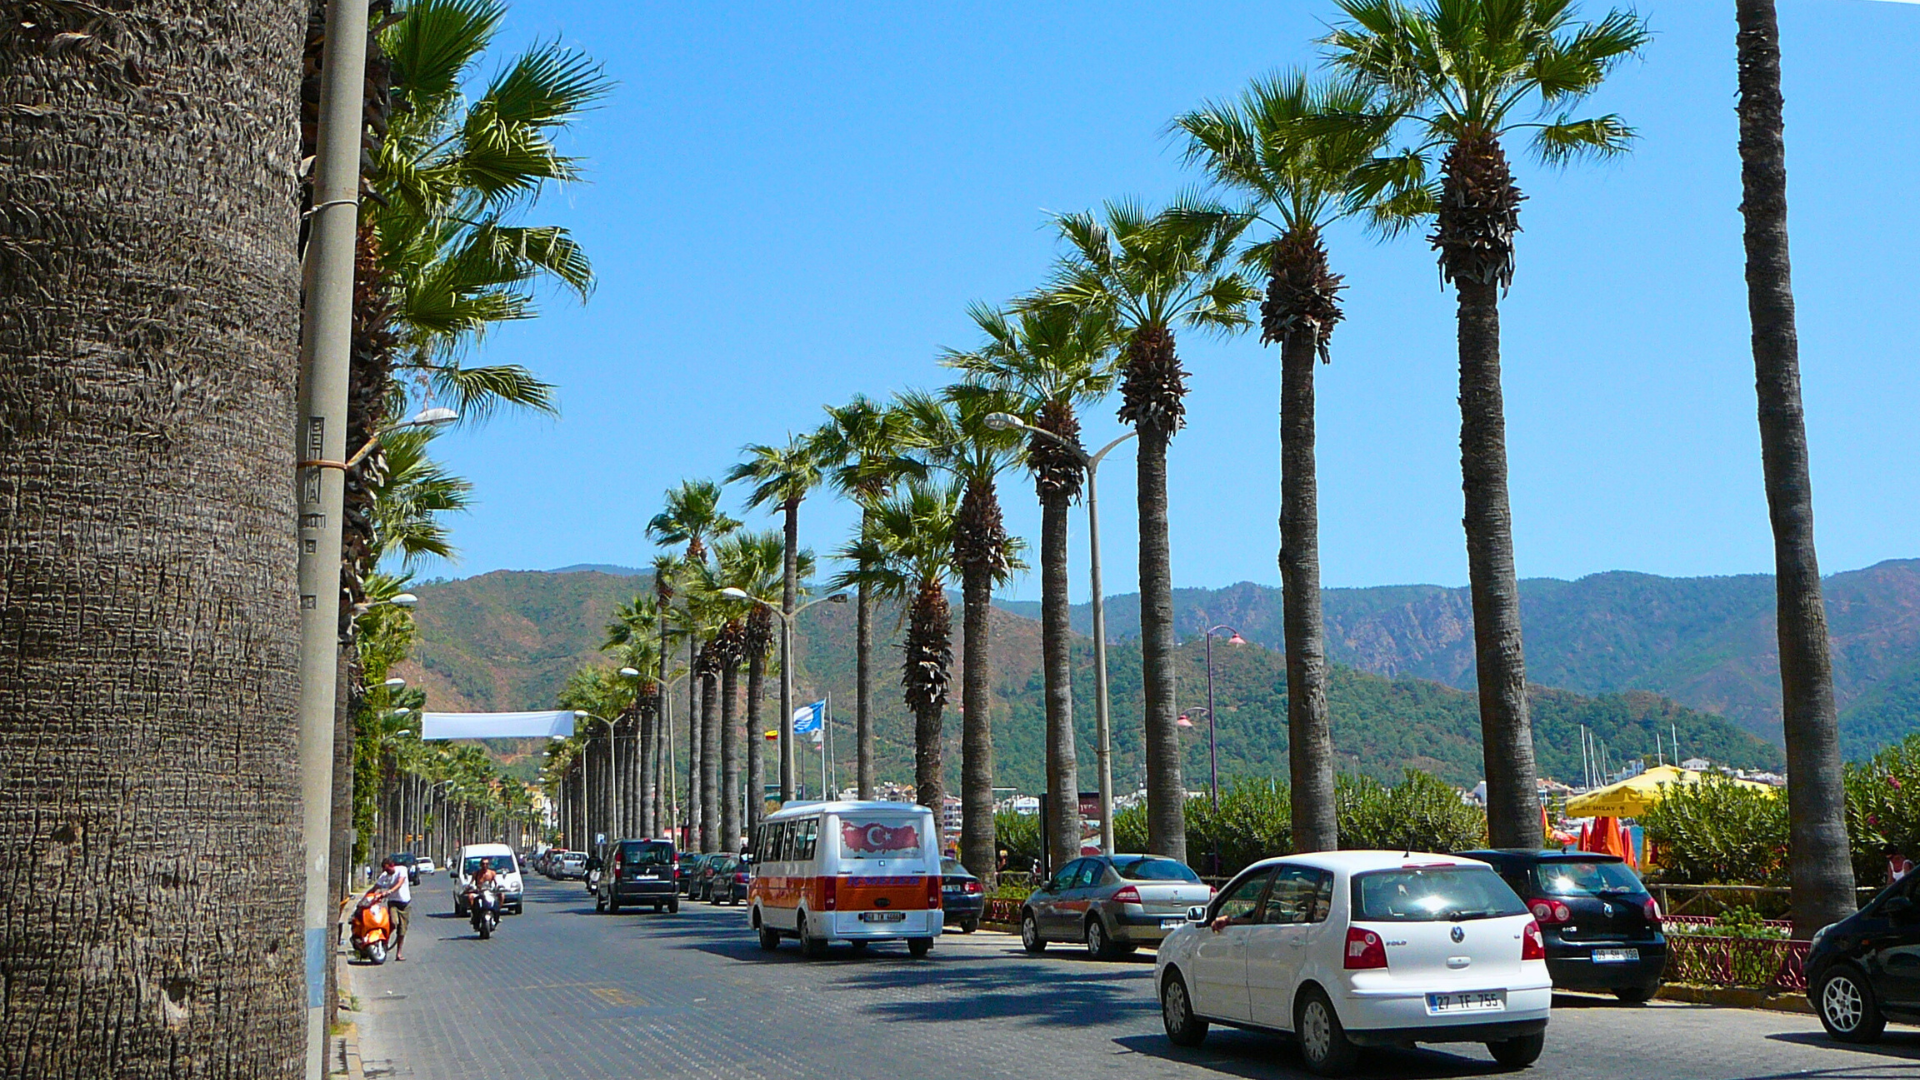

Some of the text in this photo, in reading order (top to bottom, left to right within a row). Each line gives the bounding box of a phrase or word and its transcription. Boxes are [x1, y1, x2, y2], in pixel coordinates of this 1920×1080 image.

[1437, 993, 1498, 1010] 27 TF 755
